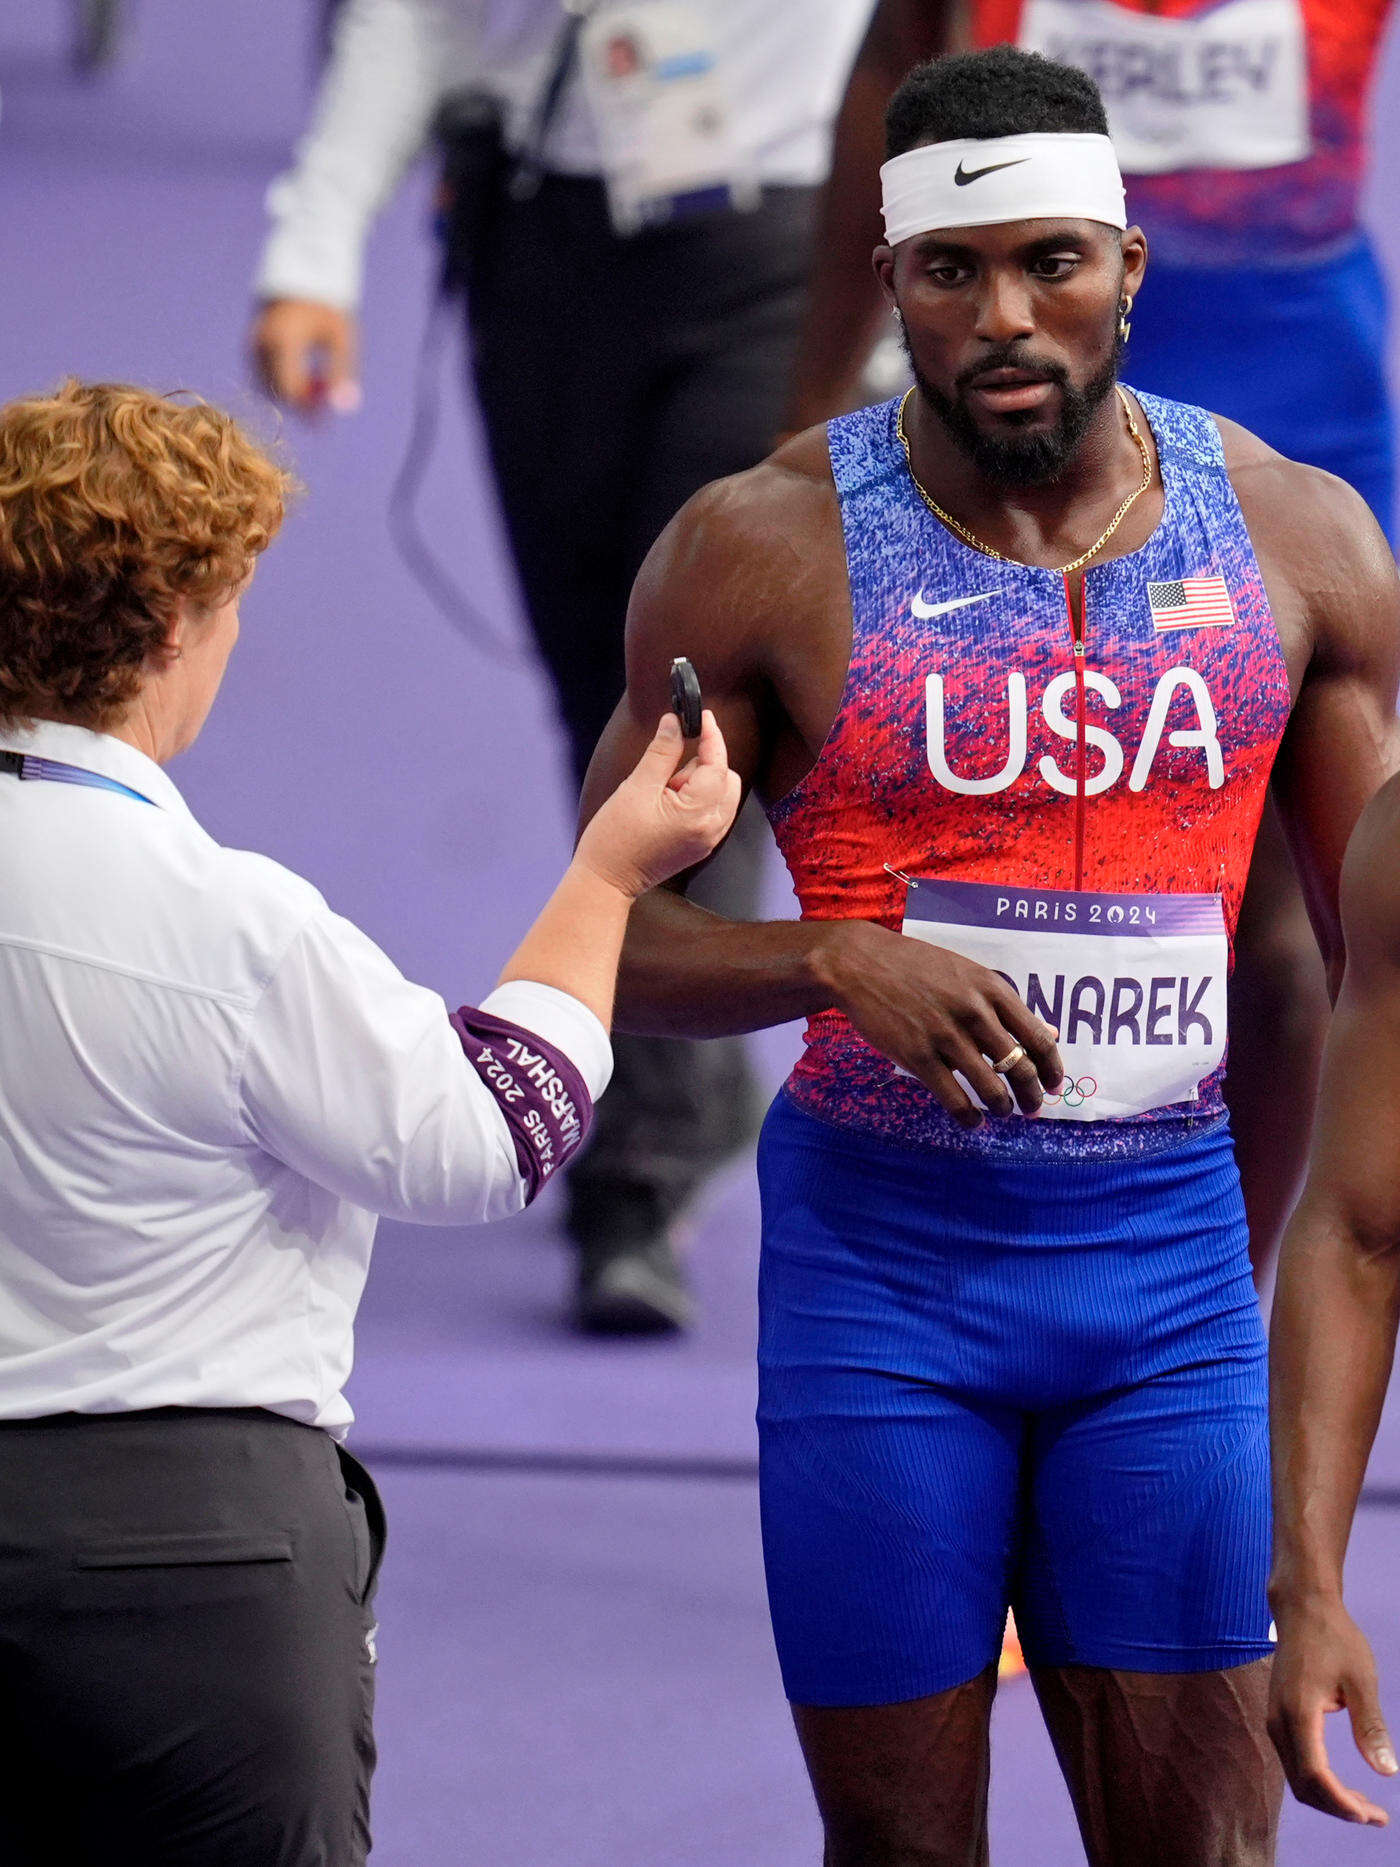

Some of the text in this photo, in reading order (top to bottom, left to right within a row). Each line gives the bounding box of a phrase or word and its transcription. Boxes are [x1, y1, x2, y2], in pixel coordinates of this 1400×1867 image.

[925, 666, 1225, 796] USA
[1089, 904, 1157, 925] 2024
[992, 968, 1213, 1046] NAREK
[476, 1046, 556, 1176] PARIS 2024
[506, 1037, 581, 1153] MARSHAL
